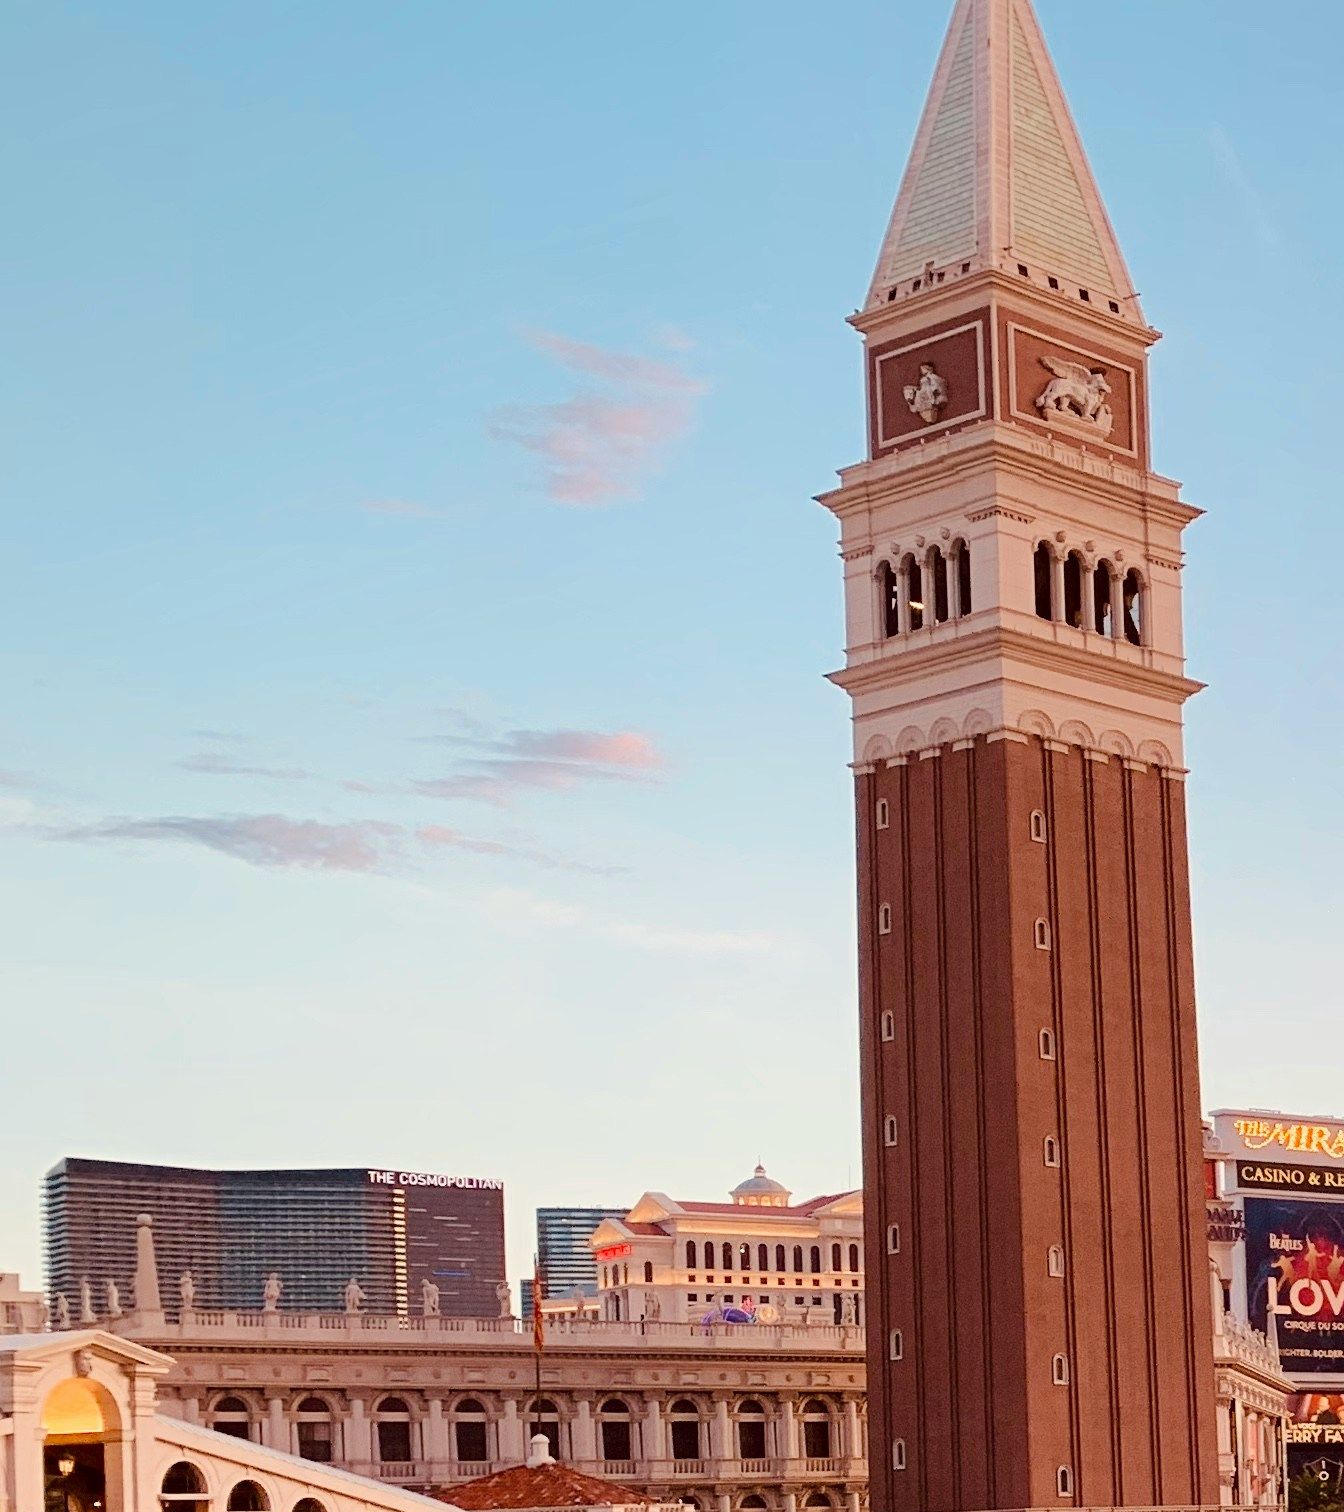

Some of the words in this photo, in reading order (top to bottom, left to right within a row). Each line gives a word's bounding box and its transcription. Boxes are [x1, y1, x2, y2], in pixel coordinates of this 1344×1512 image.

[1234, 1119, 1270, 1137] THE
[368, 1171, 395, 1184] THE
[400, 1173, 503, 1190] COSMOPOLITAN
[1241, 1167, 1305, 1184] CASINO
[1308, 1173, 1321, 1186] &
[1284, 1321, 1317, 1332] CIRQUE
[1318, 1322, 1331, 1331] DU
